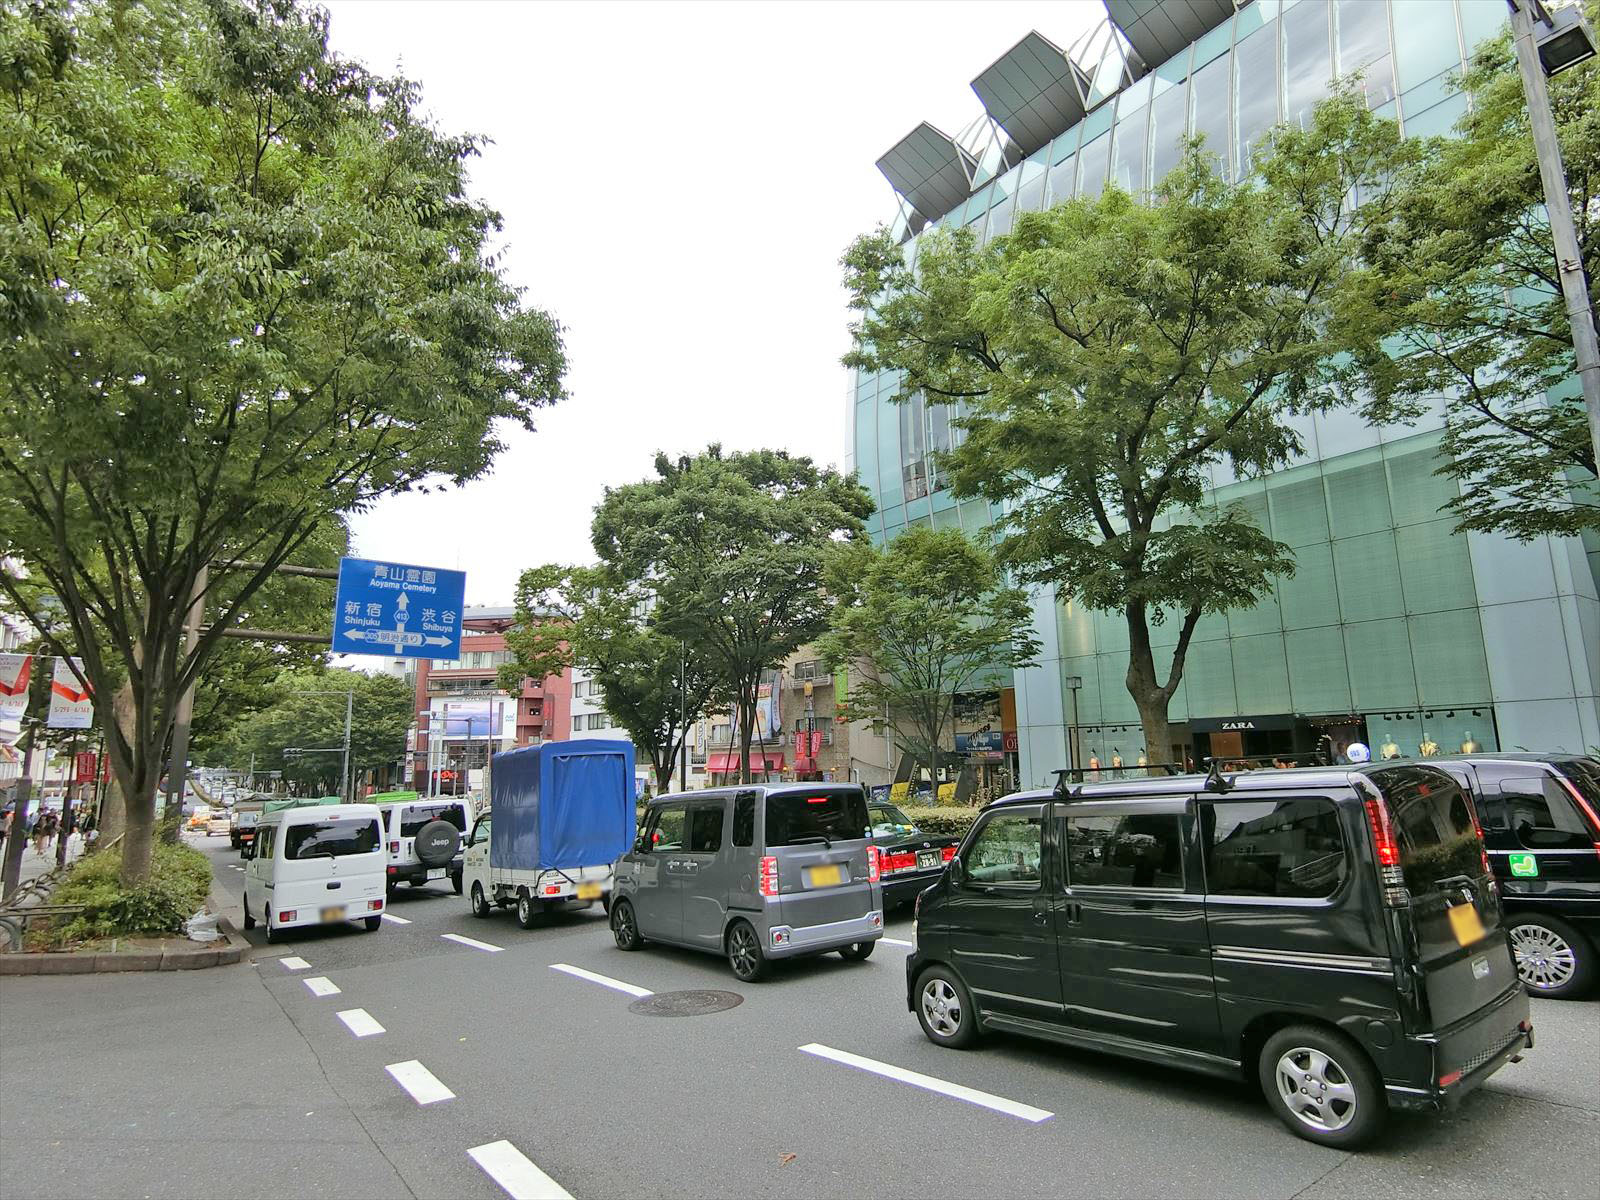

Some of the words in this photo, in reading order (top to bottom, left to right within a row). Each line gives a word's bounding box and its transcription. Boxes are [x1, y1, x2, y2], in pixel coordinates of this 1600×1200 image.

[374, 566, 436, 584] 青山霊園
[370, 578, 400, 589] Aoyama
[402, 582, 437, 594] Cemetery
[345, 600, 382, 617] 新宿
[344, 616, 381, 627] Shinjuku
[396, 612, 408, 621] 413
[421, 608, 456, 624] 渋谷
[422, 622, 453, 633] Shibuya
[380, 632, 418, 644] 明治通り
[1222, 721, 1255, 729] ZARA
[431, 838, 450, 847] Jeep
